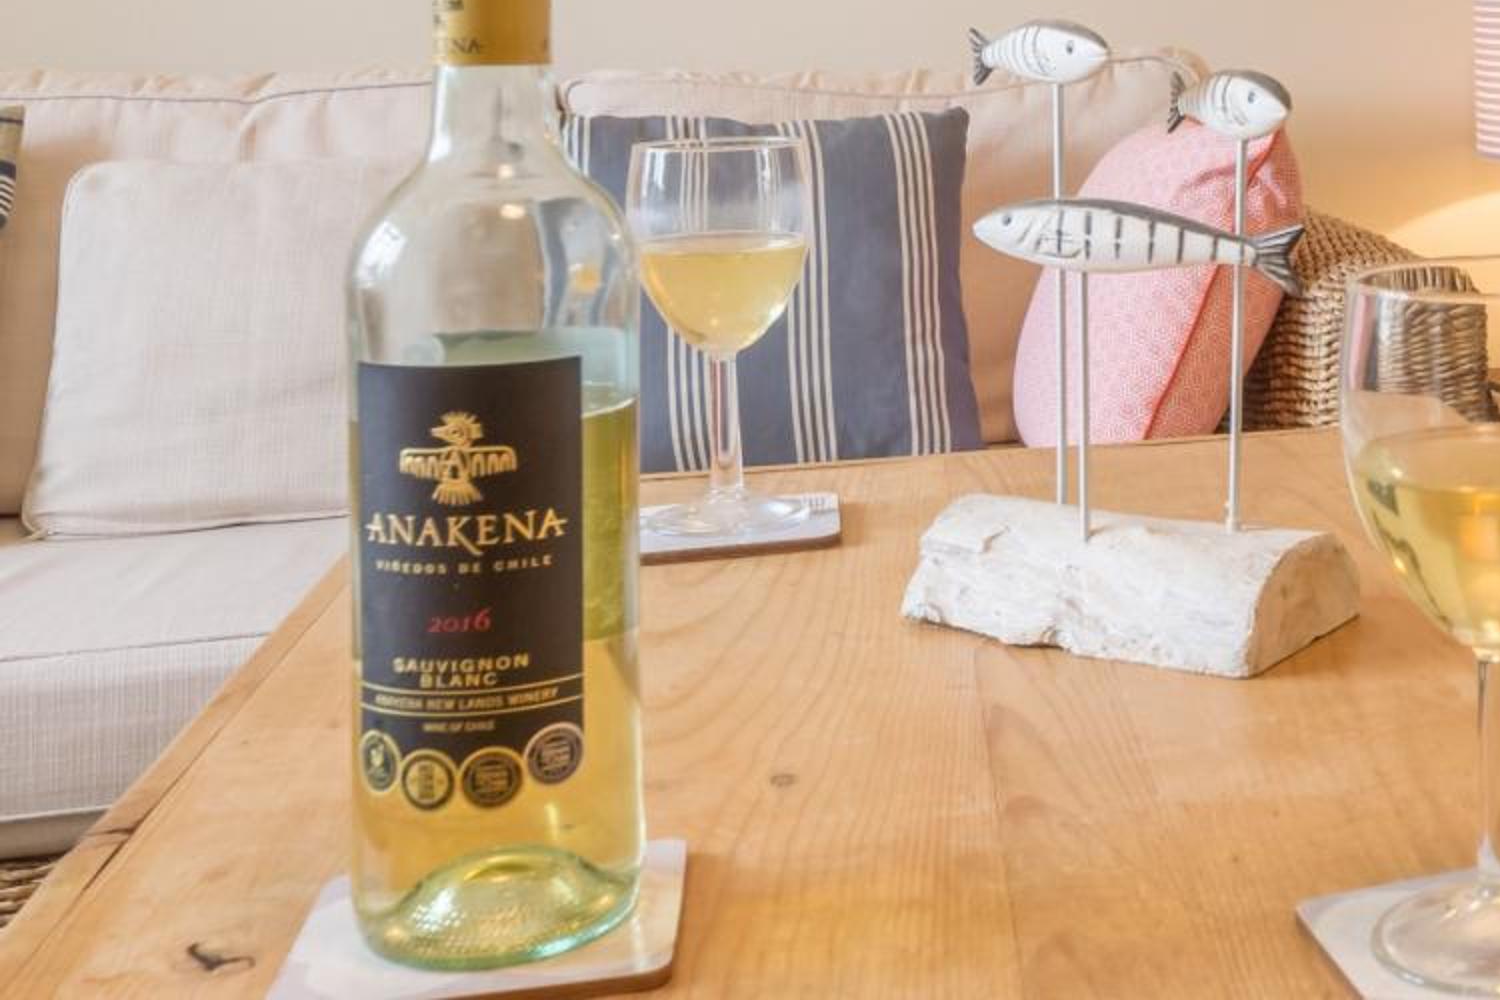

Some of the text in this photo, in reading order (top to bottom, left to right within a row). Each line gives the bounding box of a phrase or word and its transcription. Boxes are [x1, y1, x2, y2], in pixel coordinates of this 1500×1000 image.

[365, 508, 568, 556] ANAKENA
[458, 561, 481, 574] DE
[493, 555, 553, 572] CHILE
[426, 606, 494, 633] 2016
[392, 652, 530, 674] SAUVIGNON
[419, 672, 498, 689] BLANC
